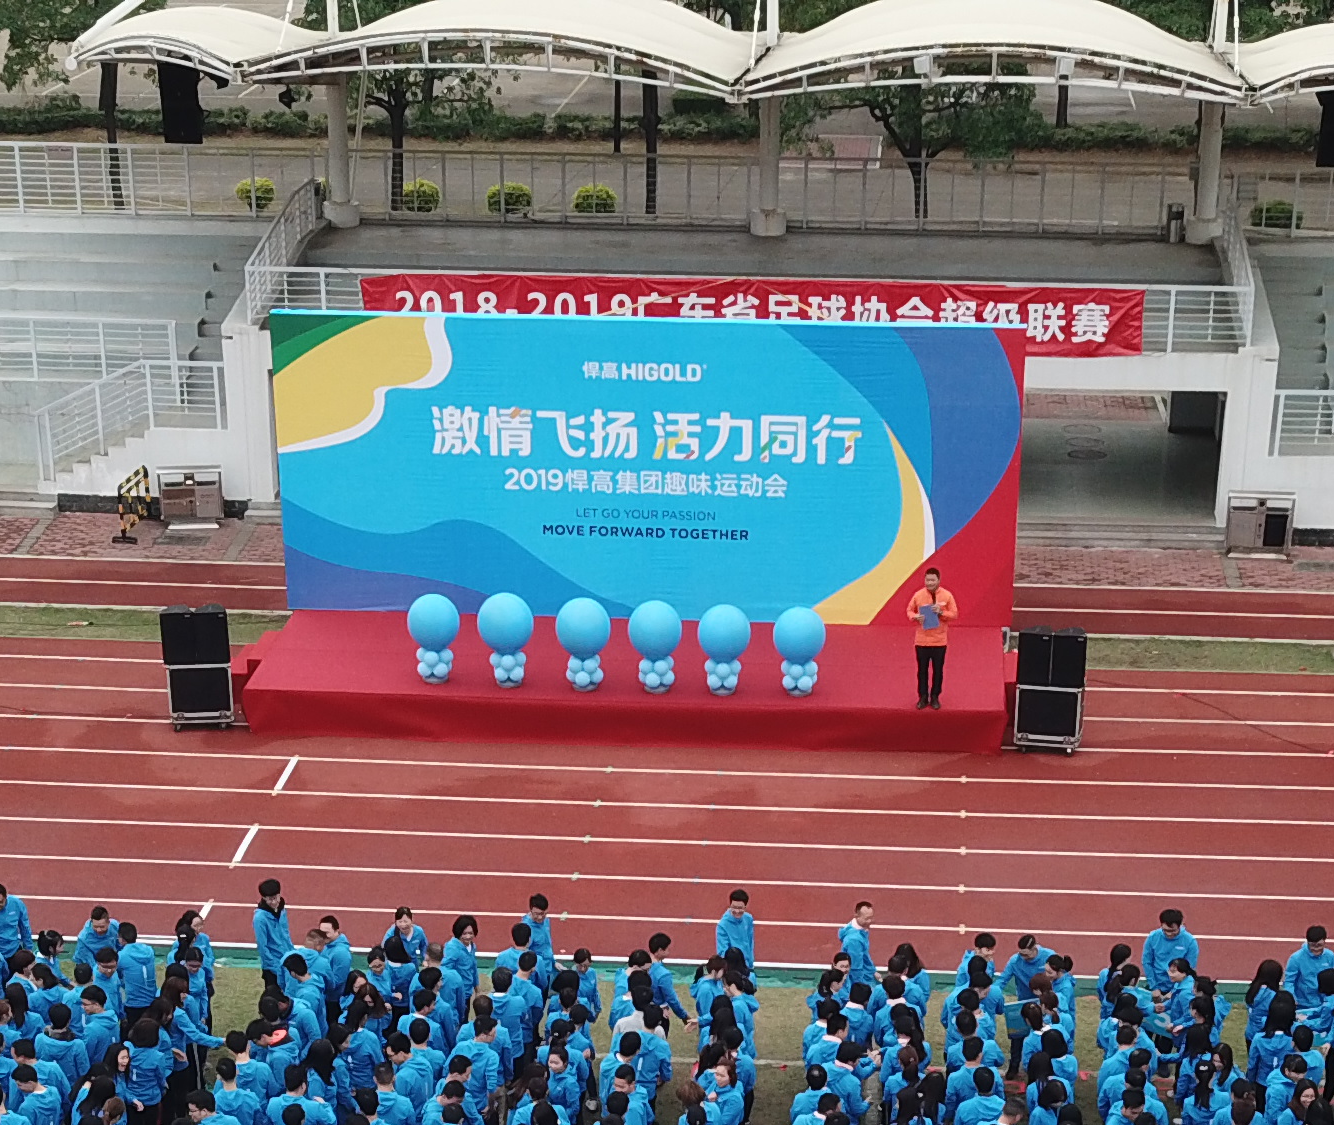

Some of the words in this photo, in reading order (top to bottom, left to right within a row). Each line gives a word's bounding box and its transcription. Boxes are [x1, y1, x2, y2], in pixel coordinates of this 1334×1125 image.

[430, 405, 638, 459] 激情飞扬
[653, 411, 862, 465] 活力同行
[504, 468, 788, 498] 2019悍高集团趣味运动会
[576, 507, 597, 518] LET
[600, 509, 621, 519] GO
[624, 509, 659, 520] YOUR
[662, 510, 716, 521] PASSION
[542, 524, 585, 536] MOVE
[589, 526, 666, 539] FORWARD
[669, 528, 749, 541] TOGETHER
